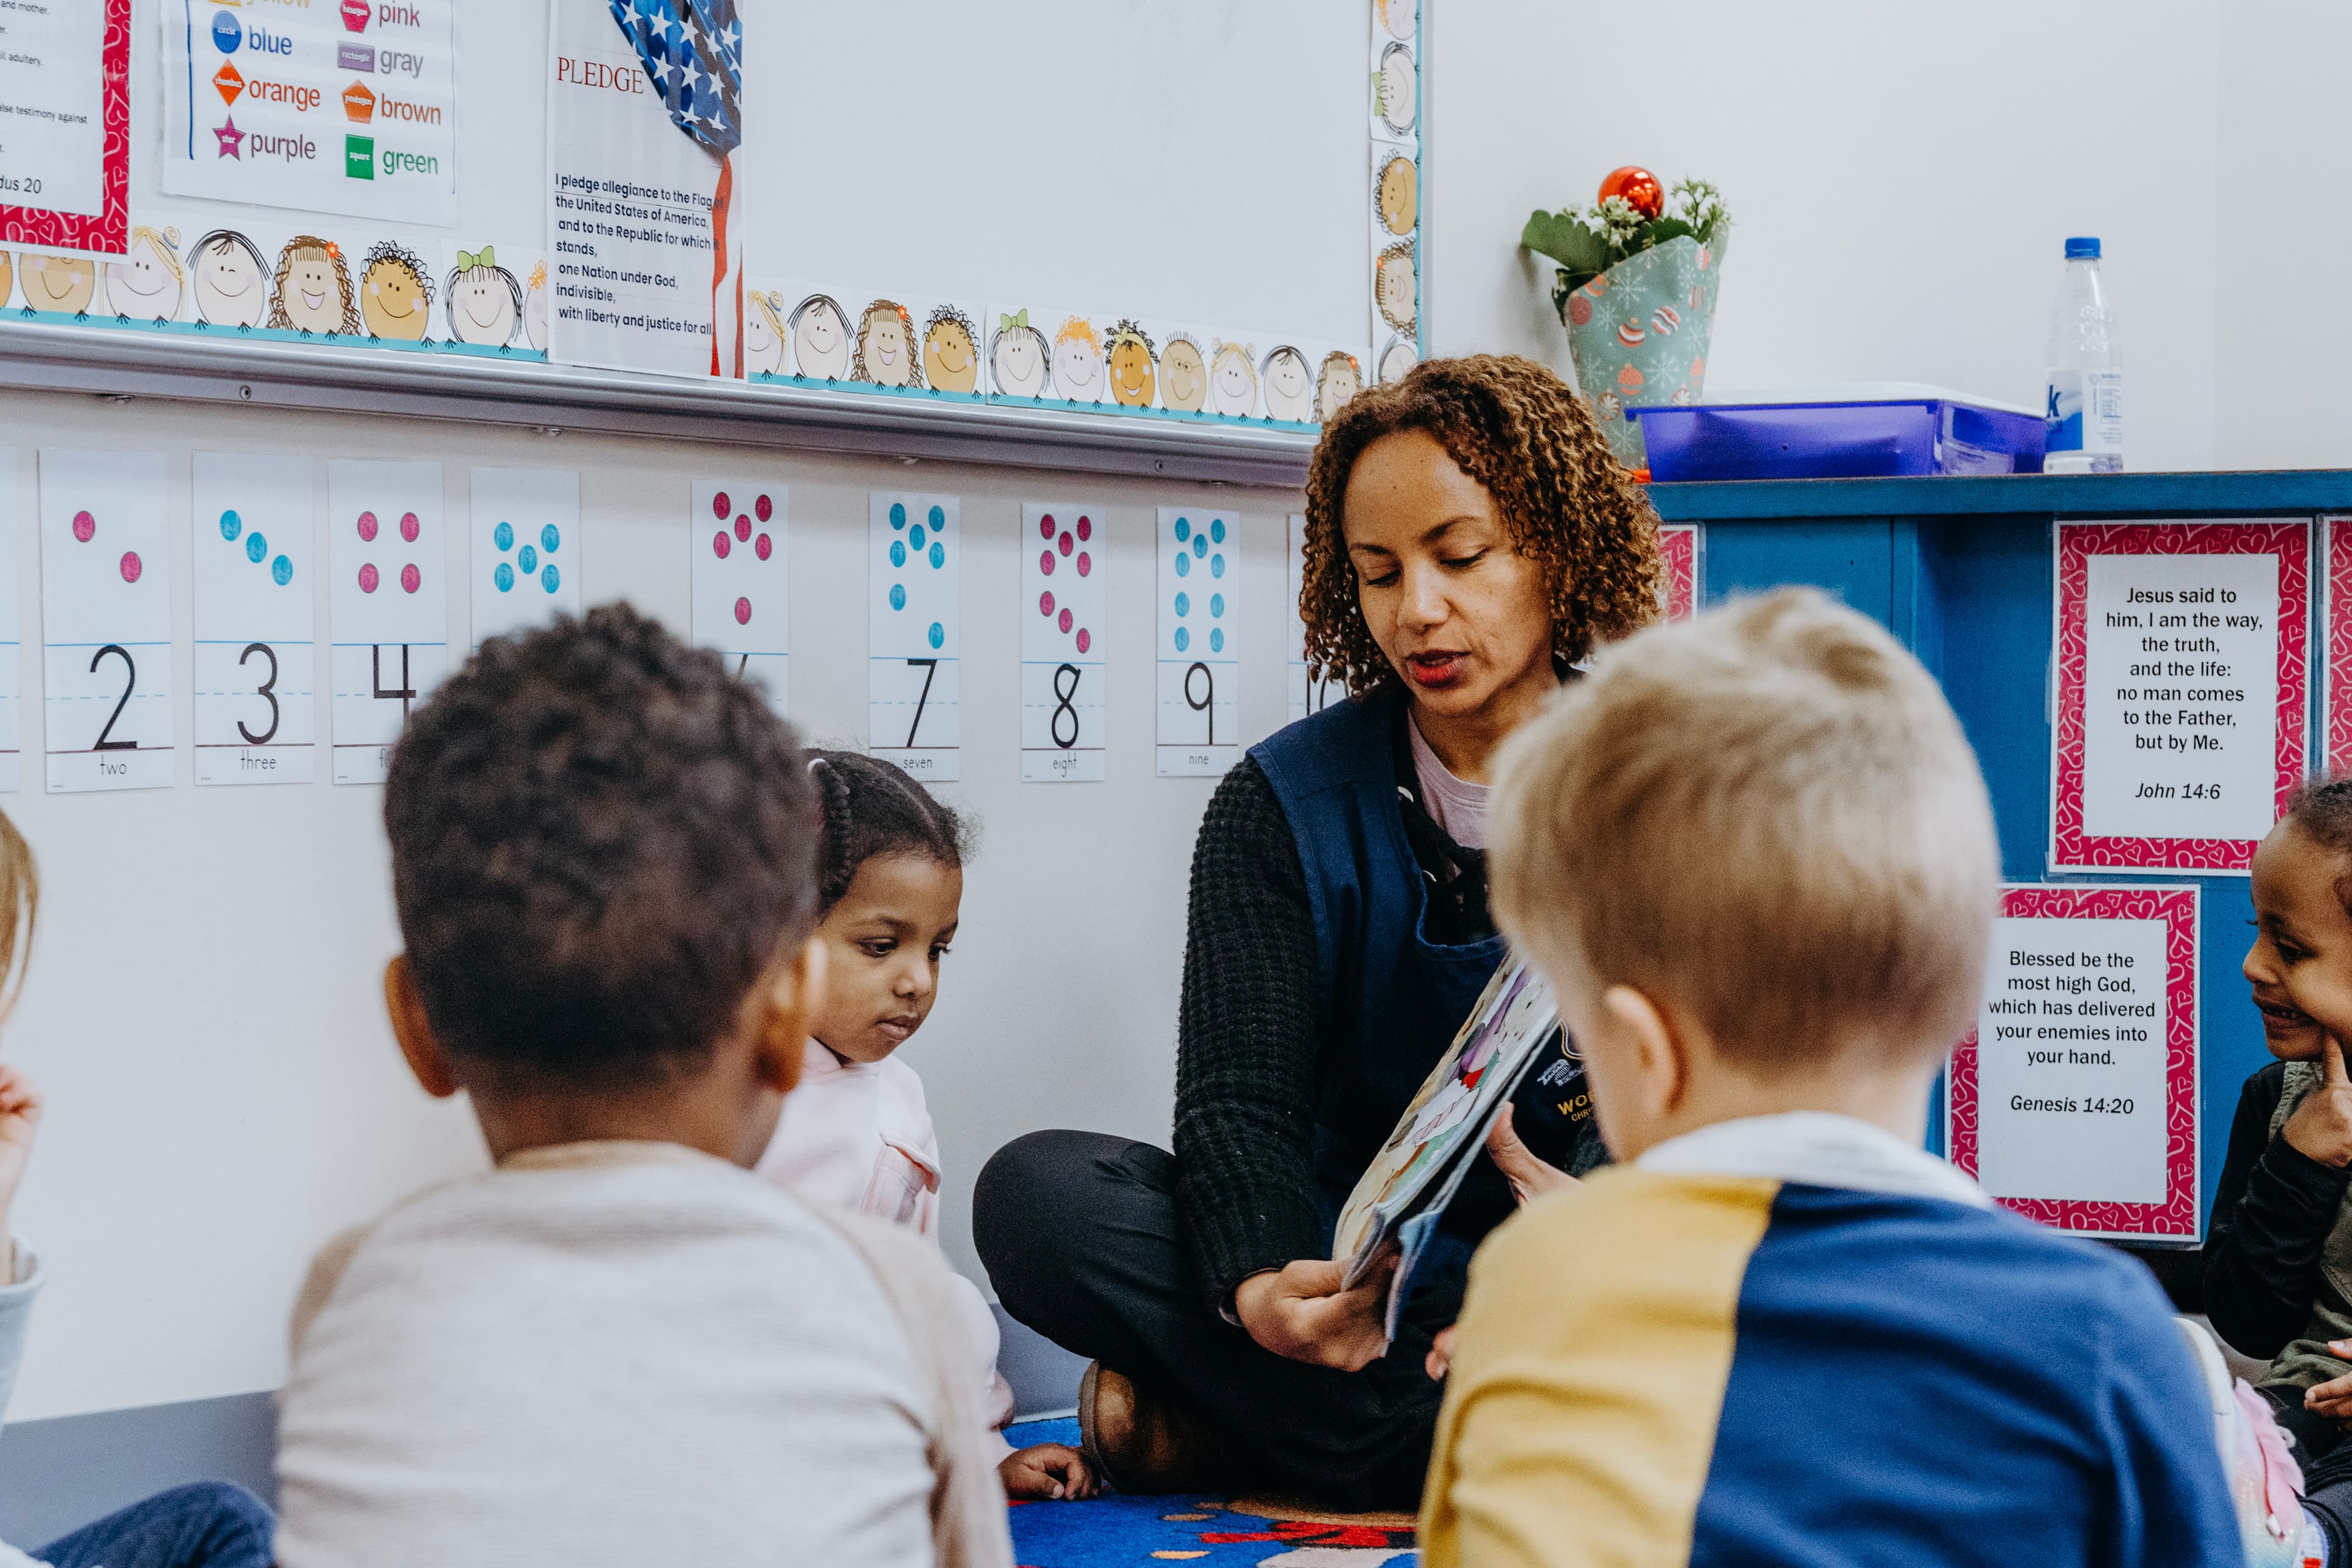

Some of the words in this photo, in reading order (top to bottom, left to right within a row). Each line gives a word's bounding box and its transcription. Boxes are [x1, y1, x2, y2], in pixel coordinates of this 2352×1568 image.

[0, 1, 16, 9] and
[18, 3, 49, 15] mother.
[379, 0, 420, 28] pink
[249, 24, 292, 55] blue
[9, 53, 43, 67] adultery.
[380, 50, 424, 79] gray
[557, 56, 644, 94] PLEDGE
[249, 80, 320, 111] orange
[16, 106, 56, 121] testimony
[58, 113, 88, 124] against
[381, 92, 441, 125] brown
[251, 133, 315, 164] purple
[383, 150, 438, 176] green
[23, 178, 42, 194] 20
[556, 173, 559, 185] I
[562, 175, 600, 194] pledge
[602, 180, 658, 198] allegiance
[661, 189, 671, 201] to
[673, 190, 690, 203] the
[692, 193, 712, 211] Flag
[556, 195, 573, 208] the
[576, 198, 611, 214] United
[615, 203, 648, 219] States
[651, 208, 662, 221] of
[664, 211, 709, 230] America,
[559, 219, 579, 232] and
[582, 221, 594, 233] to
[596, 222, 613, 236] the
[616, 225, 662, 243] Republic
[665, 231, 679, 245] for
[681, 235, 710, 250] which
[556, 240, 597, 258] stands,
[559, 264, 579, 275] one
[582, 265, 617, 281] Nation
[620, 271, 652, 285] under
[655, 274, 678, 290] God,
[556, 282, 616, 304] indivisible,
[559, 306, 582, 320] with
[586, 308, 620, 328] liberty
[623, 315, 644, 327] and
[646, 315, 681, 332] justice
[684, 320, 698, 333] for
[2126, 587, 2174, 603] Jesus
[2179, 587, 2215, 603] said
[2220, 588, 2237, 603] to
[2106, 612, 2143, 629] him,
[2149, 612, 2153, 627] I
[2159, 615, 2186, 627] am
[2192, 612, 2220, 628] the
[2225, 616, 2263, 631] way,
[2141, 636, 2169, 652] the
[2174, 636, 2220, 654] truth,
[2130, 661, 2162, 676] and
[2167, 661, 2195, 677] the
[2201, 661, 2231, 677] life:
[89, 644, 138, 751] 2
[237, 643, 279, 745] 3
[372, 644, 417, 733] 4
[2117, 688, 2138, 701] no
[2144, 688, 2181, 701] man
[2187, 689, 2244, 701] comes
[907, 658, 938, 748] 7
[1052, 663, 1081, 748] 8
[1185, 662, 1213, 745] 9
[2123, 710, 2139, 725] to
[2144, 709, 2172, 725] the
[2178, 710, 2236, 727] Father,
[2136, 734, 2163, 750] but
[2169, 734, 2188, 753] by
[2193, 734, 2223, 750] Me.
[100, 754, 127, 775] two
[240, 749, 276, 769] three
[903, 759, 932, 769] seven
[1053, 752, 1077, 777] eight
[1189, 752, 1209, 765] nine
[2135, 783, 2175, 799] John
[2181, 783, 2221, 799] 14:6
[2010, 951, 2075, 967] Blessed
[2081, 952, 2101, 968] be
[2107, 952, 2134, 968] the
[2008, 976, 2051, 990] most
[2056, 975, 2091, 995] high
[2097, 976, 2135, 995] God,
[1988, 998, 2037, 1014] which
[2043, 1000, 2073, 1016] has
[2078, 1000, 2155, 1017] delivered
[1996, 1026, 2032, 1041] your
[2037, 1025, 2110, 1041] enemies
[2116, 1025, 2147, 1042] into
[2027, 1051, 2064, 1066] your
[2069, 1049, 2116, 1065] hand.
[2010, 1095, 2077, 1112] Genesis
[2082, 1097, 2134, 1115] 14:20
